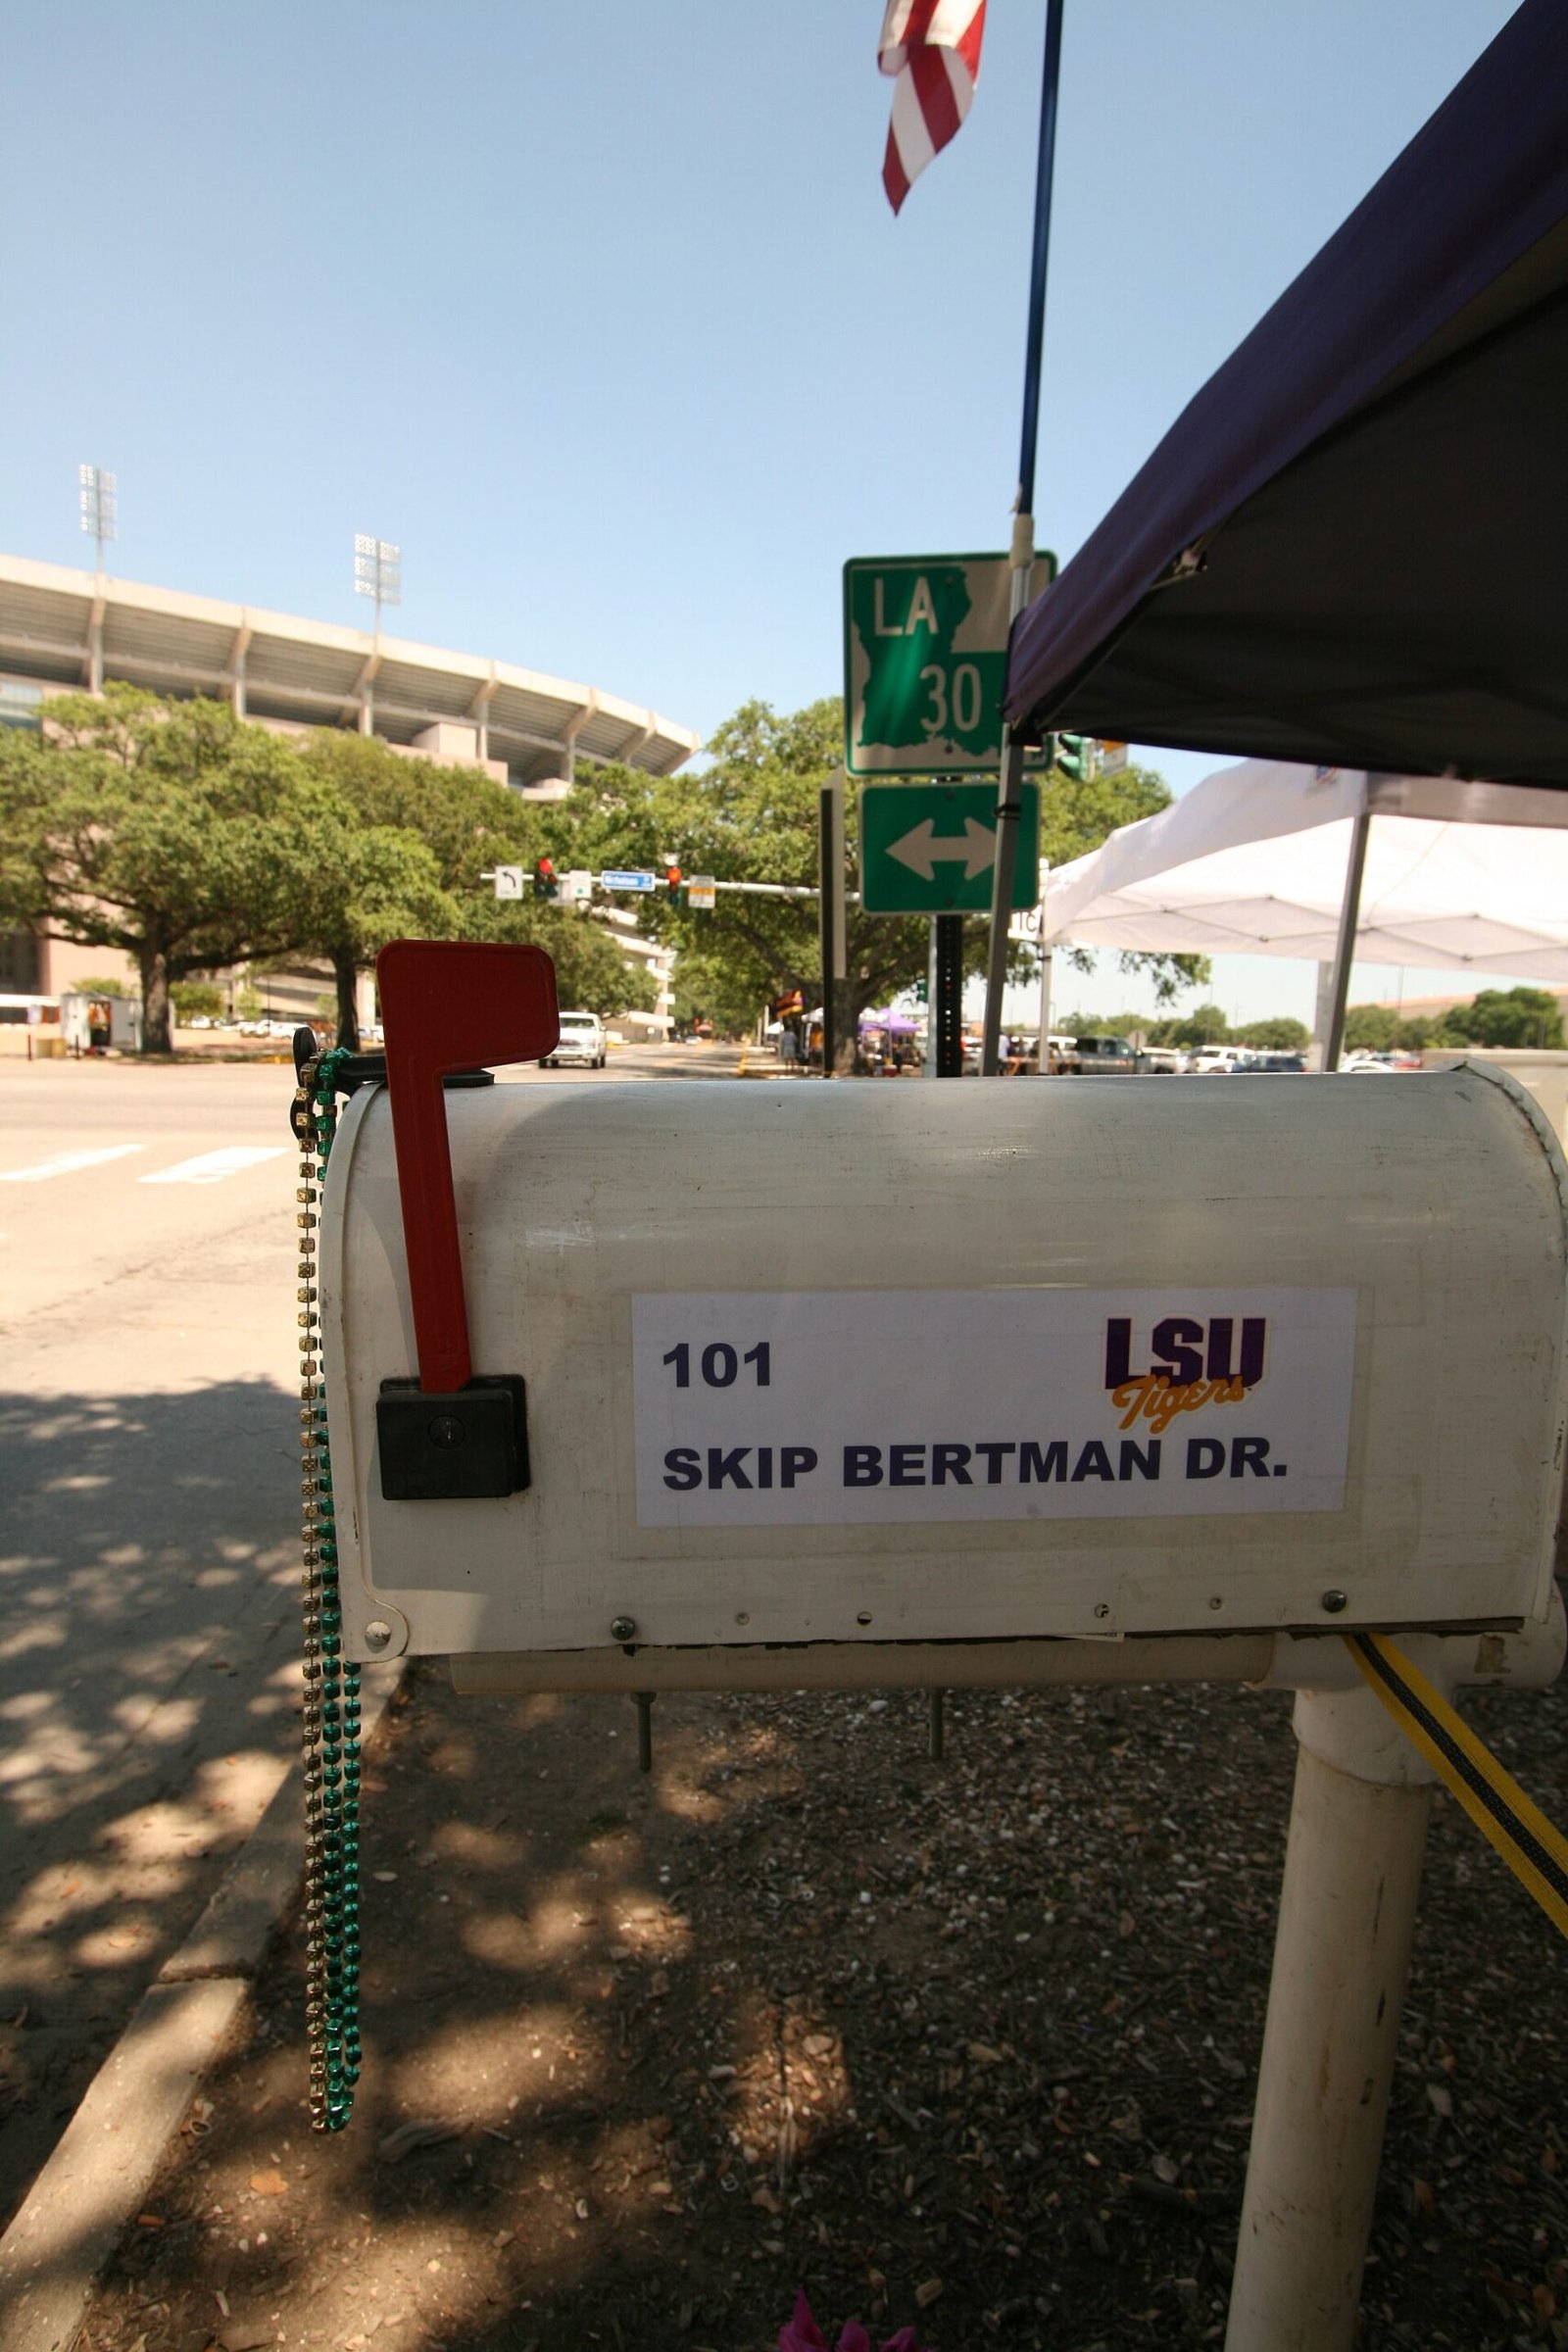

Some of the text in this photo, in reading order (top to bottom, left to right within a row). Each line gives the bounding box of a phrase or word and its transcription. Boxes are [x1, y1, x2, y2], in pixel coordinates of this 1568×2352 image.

[874, 576, 939, 637] LA
[919, 663, 982, 732] 30
[663, 1342, 770, 1388] 101
[1104, 1317, 1266, 1390] LSU
[1112, 1374, 1245, 1434] Tigers
[663, 1437, 1288, 1491] SKIP BERTMAN DR.
